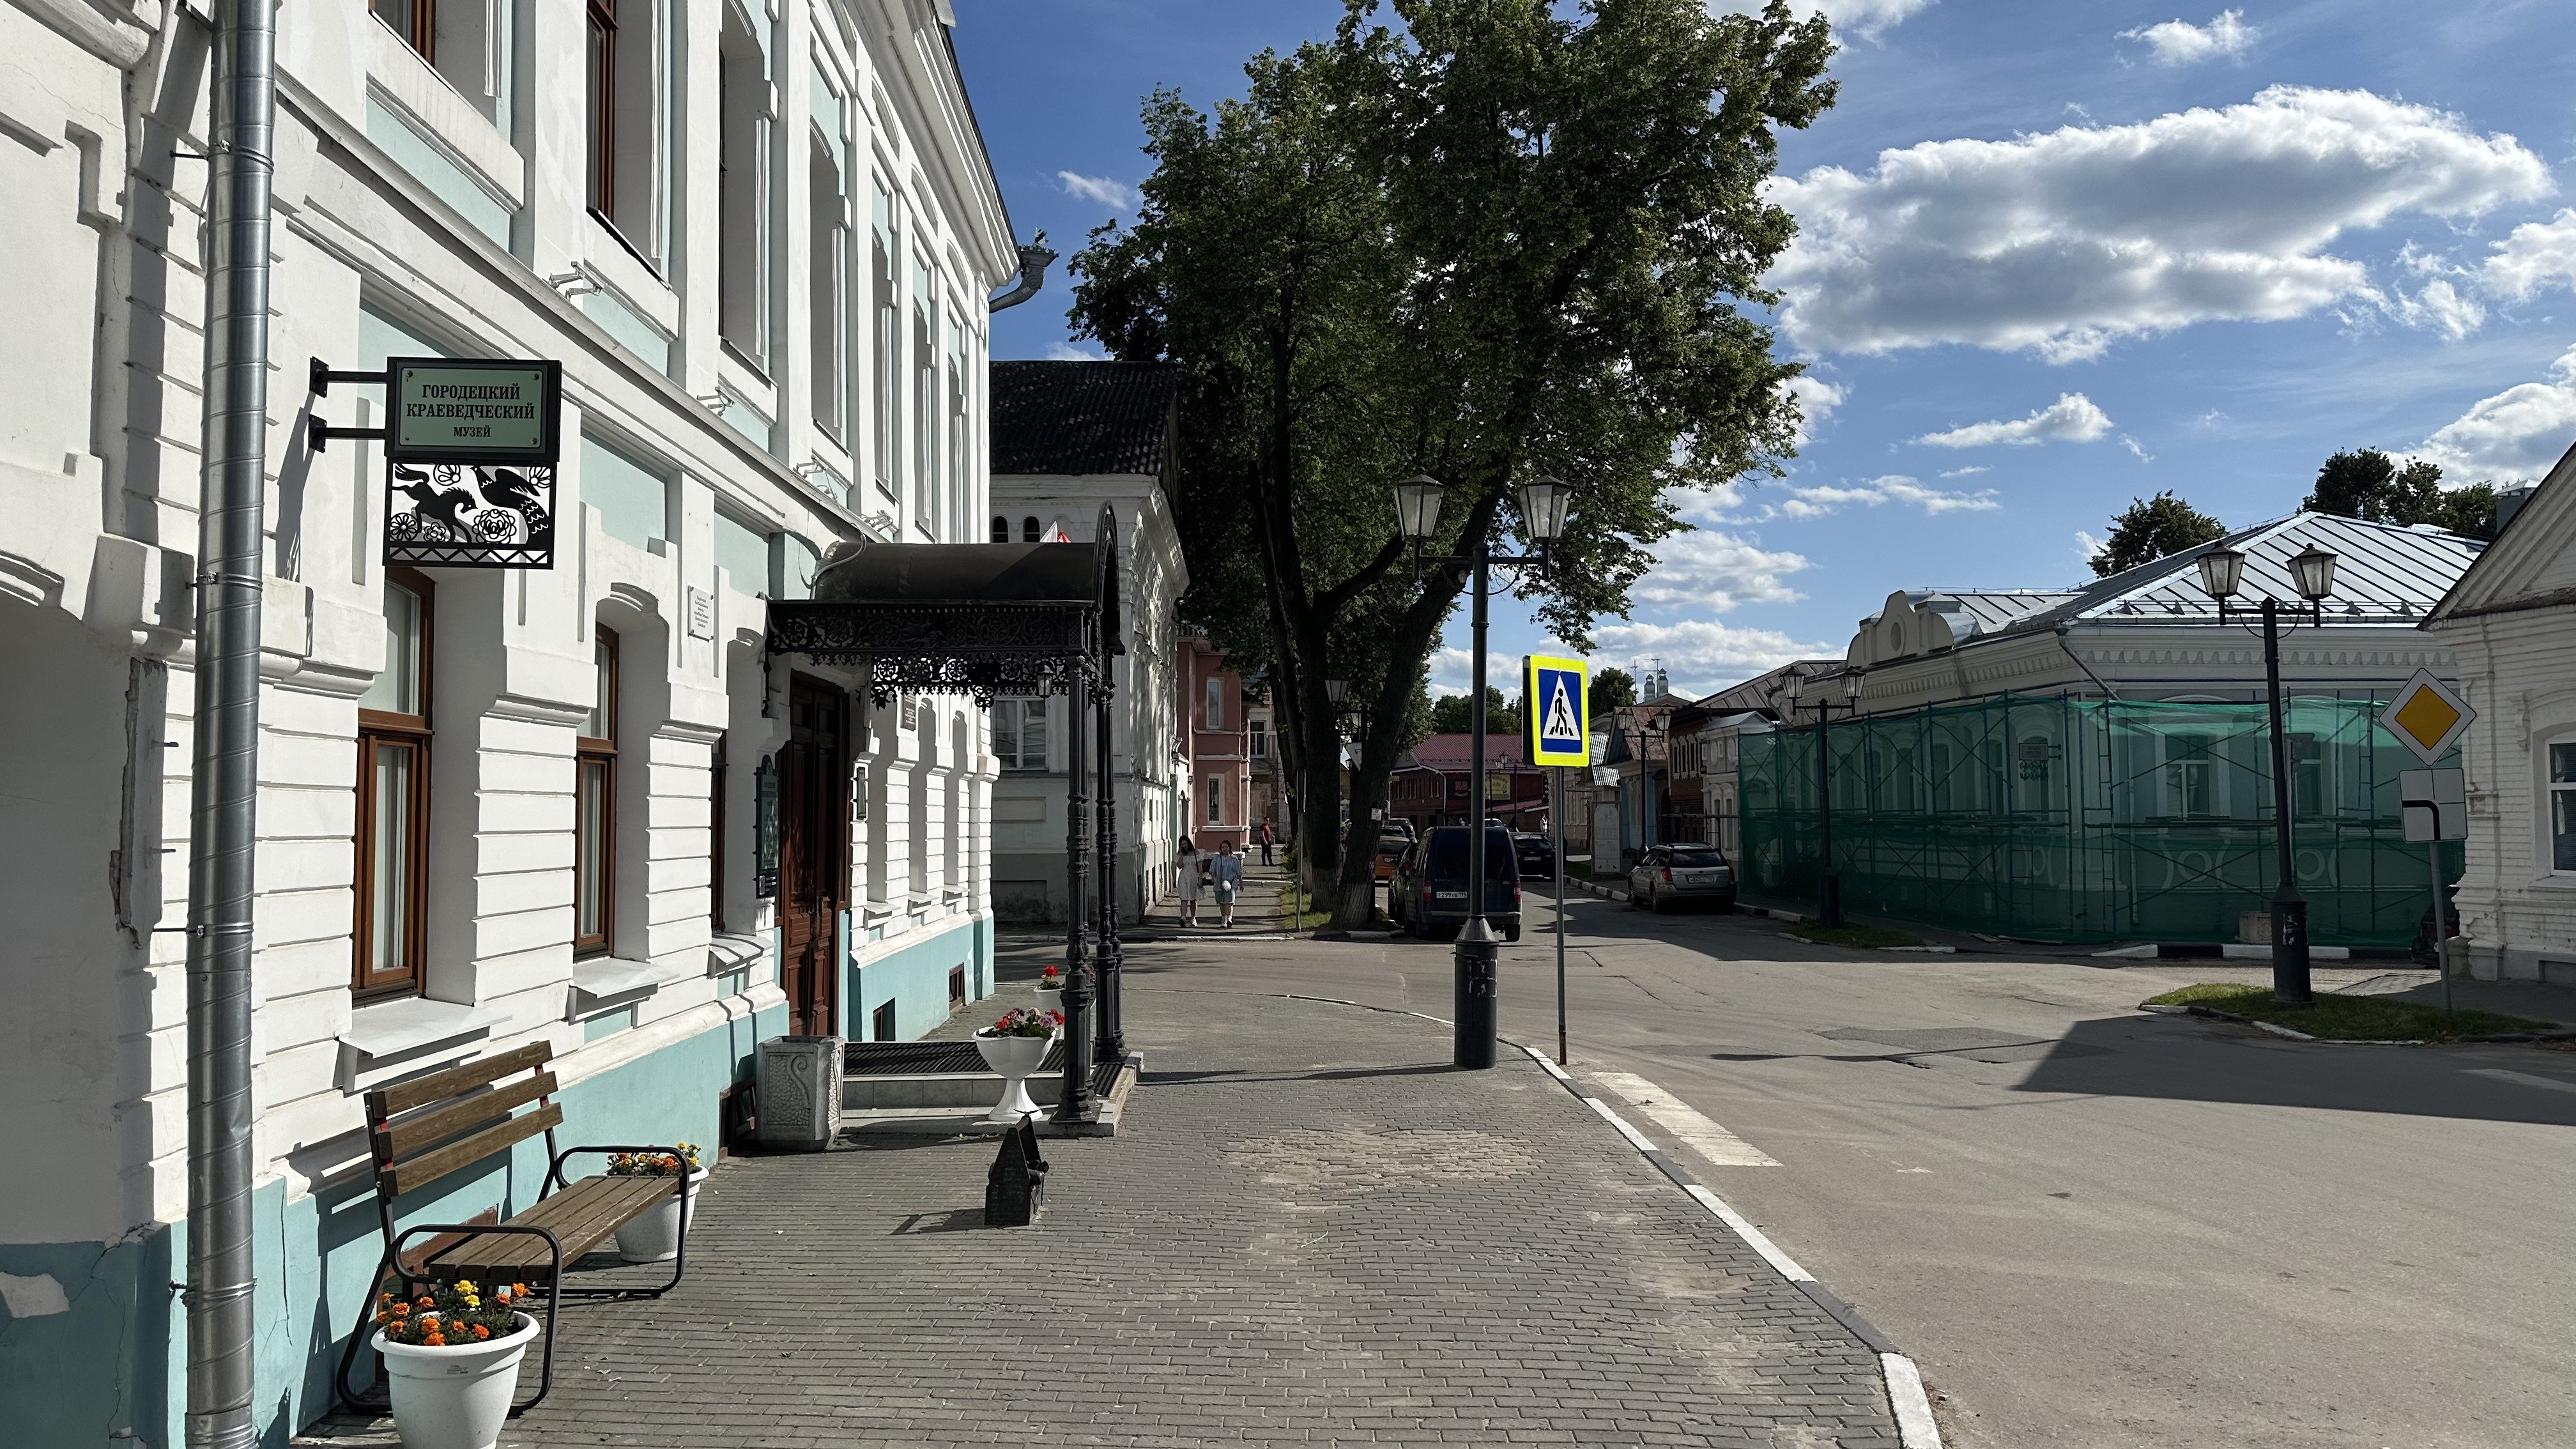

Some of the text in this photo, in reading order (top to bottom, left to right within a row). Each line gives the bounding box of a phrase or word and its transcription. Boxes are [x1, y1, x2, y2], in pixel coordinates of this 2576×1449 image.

[422, 383, 521, 401] ГОРОДЕЦКИЙ
[406, 402, 535, 420] КРАЕВЕДЧЕСКИЙ
[453, 425, 491, 438] МУЗЕЙ
